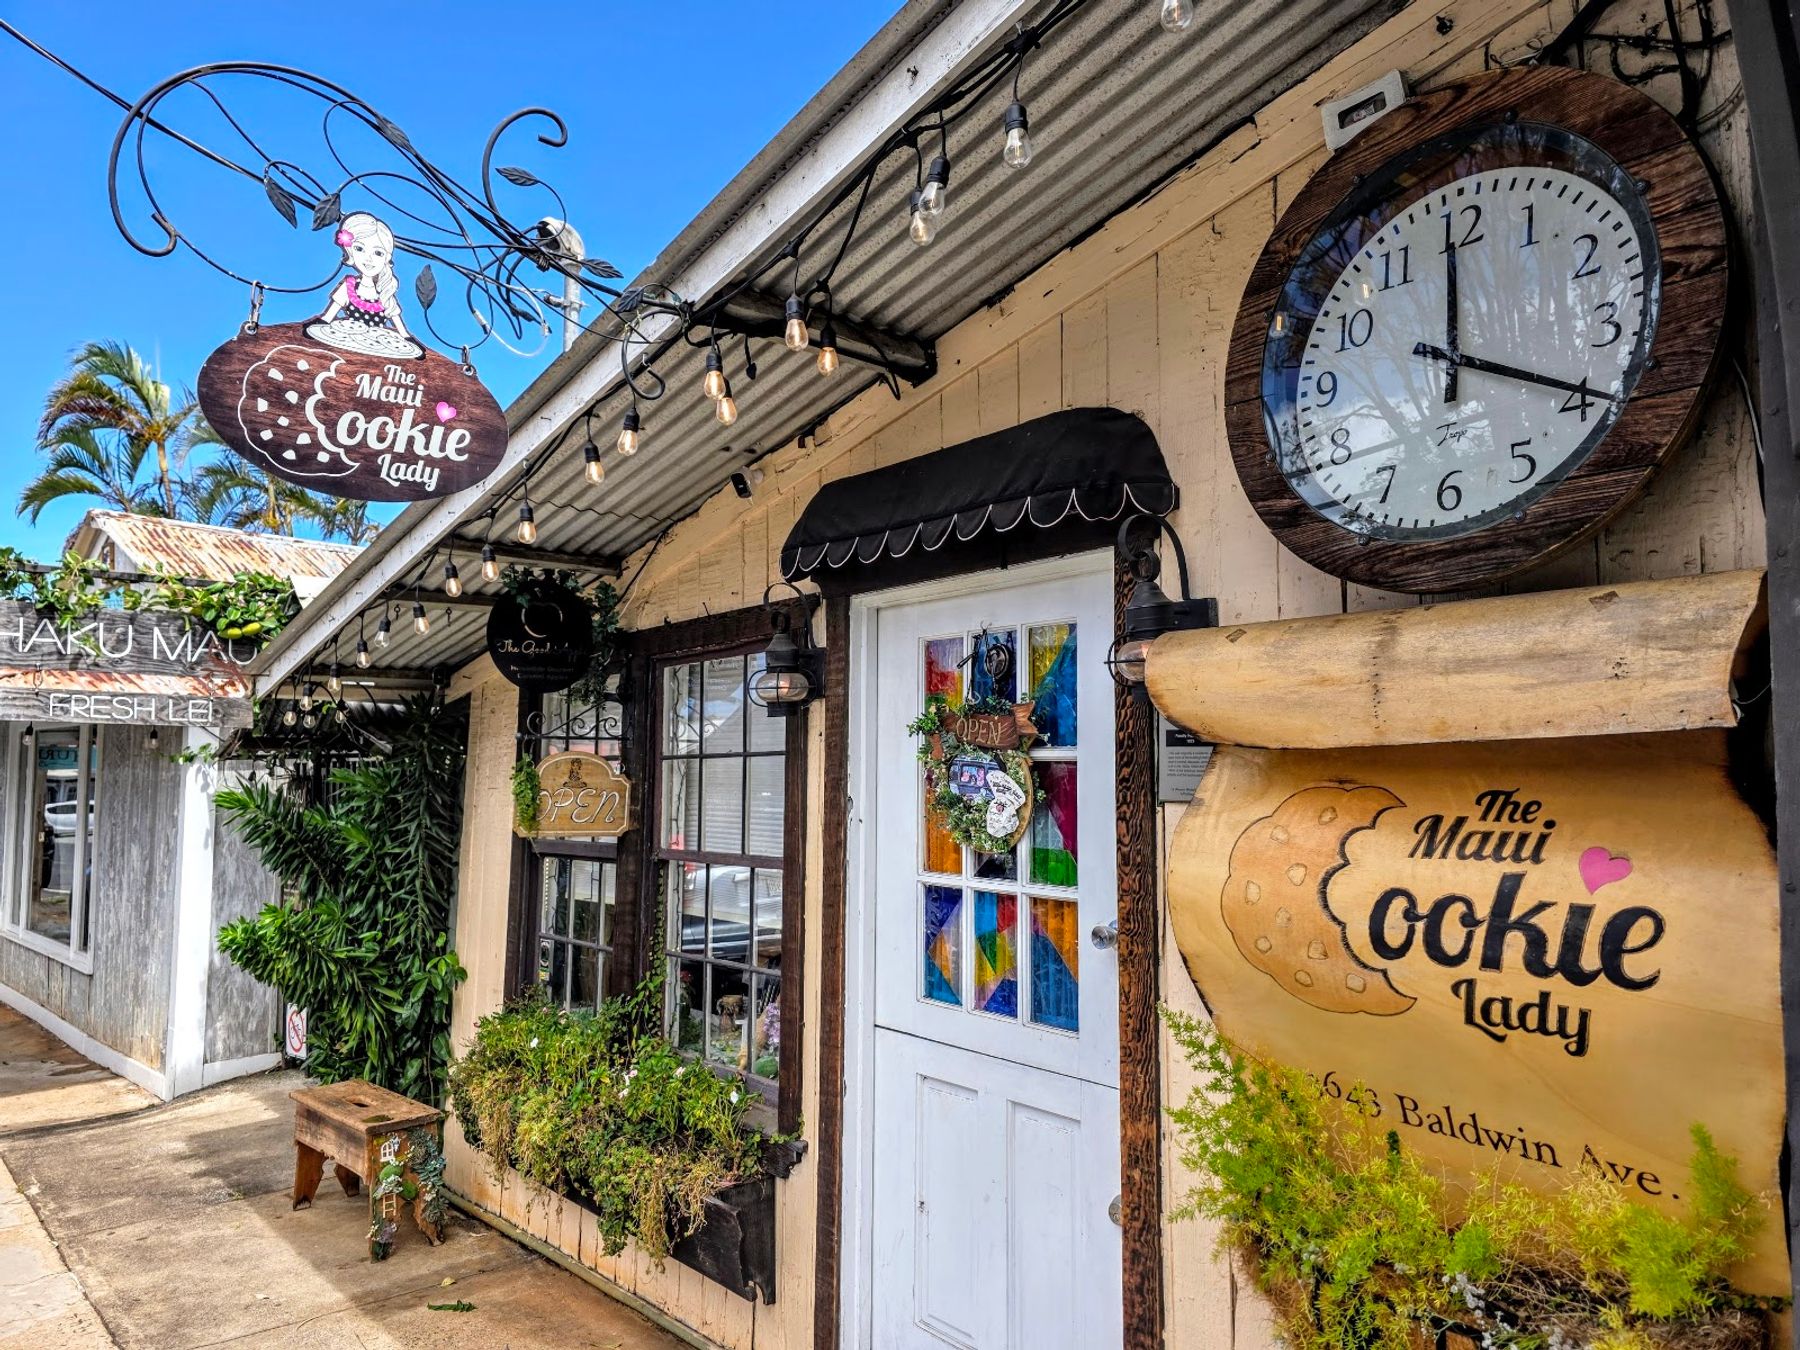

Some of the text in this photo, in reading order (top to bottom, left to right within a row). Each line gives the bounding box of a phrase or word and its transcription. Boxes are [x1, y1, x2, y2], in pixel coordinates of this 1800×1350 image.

[1439, 205, 1484, 255] 12
[1520, 203, 1541, 249] 1
[1378, 245, 1415, 292] 11
[1572, 233, 1601, 280] 2
[1335, 308, 1374, 354] 10
[1591, 302, 1622, 348] 3
[355, 374, 424, 407] Maui
[384, 364, 416, 386] The
[1315, 370, 1338, 407] 9
[1558, 376, 1595, 422] 4
[1329, 428, 1352, 465] 8
[1508, 438, 1538, 484] 5
[377, 454, 440, 492] Lady
[1375, 465, 1398, 504] 7
[1436, 469, 1463, 511] 6
[0, 617, 133, 658] HAKU
[50, 693, 213, 723] FRESH LEI
[956, 718, 1002, 745] OPEN
[1475, 787, 1542, 824] The
[1408, 814, 1557, 865] Maui
[1451, 978, 1592, 1058] Lady
[1309, 1070, 1680, 1199] 643 Baldwin Ave.
